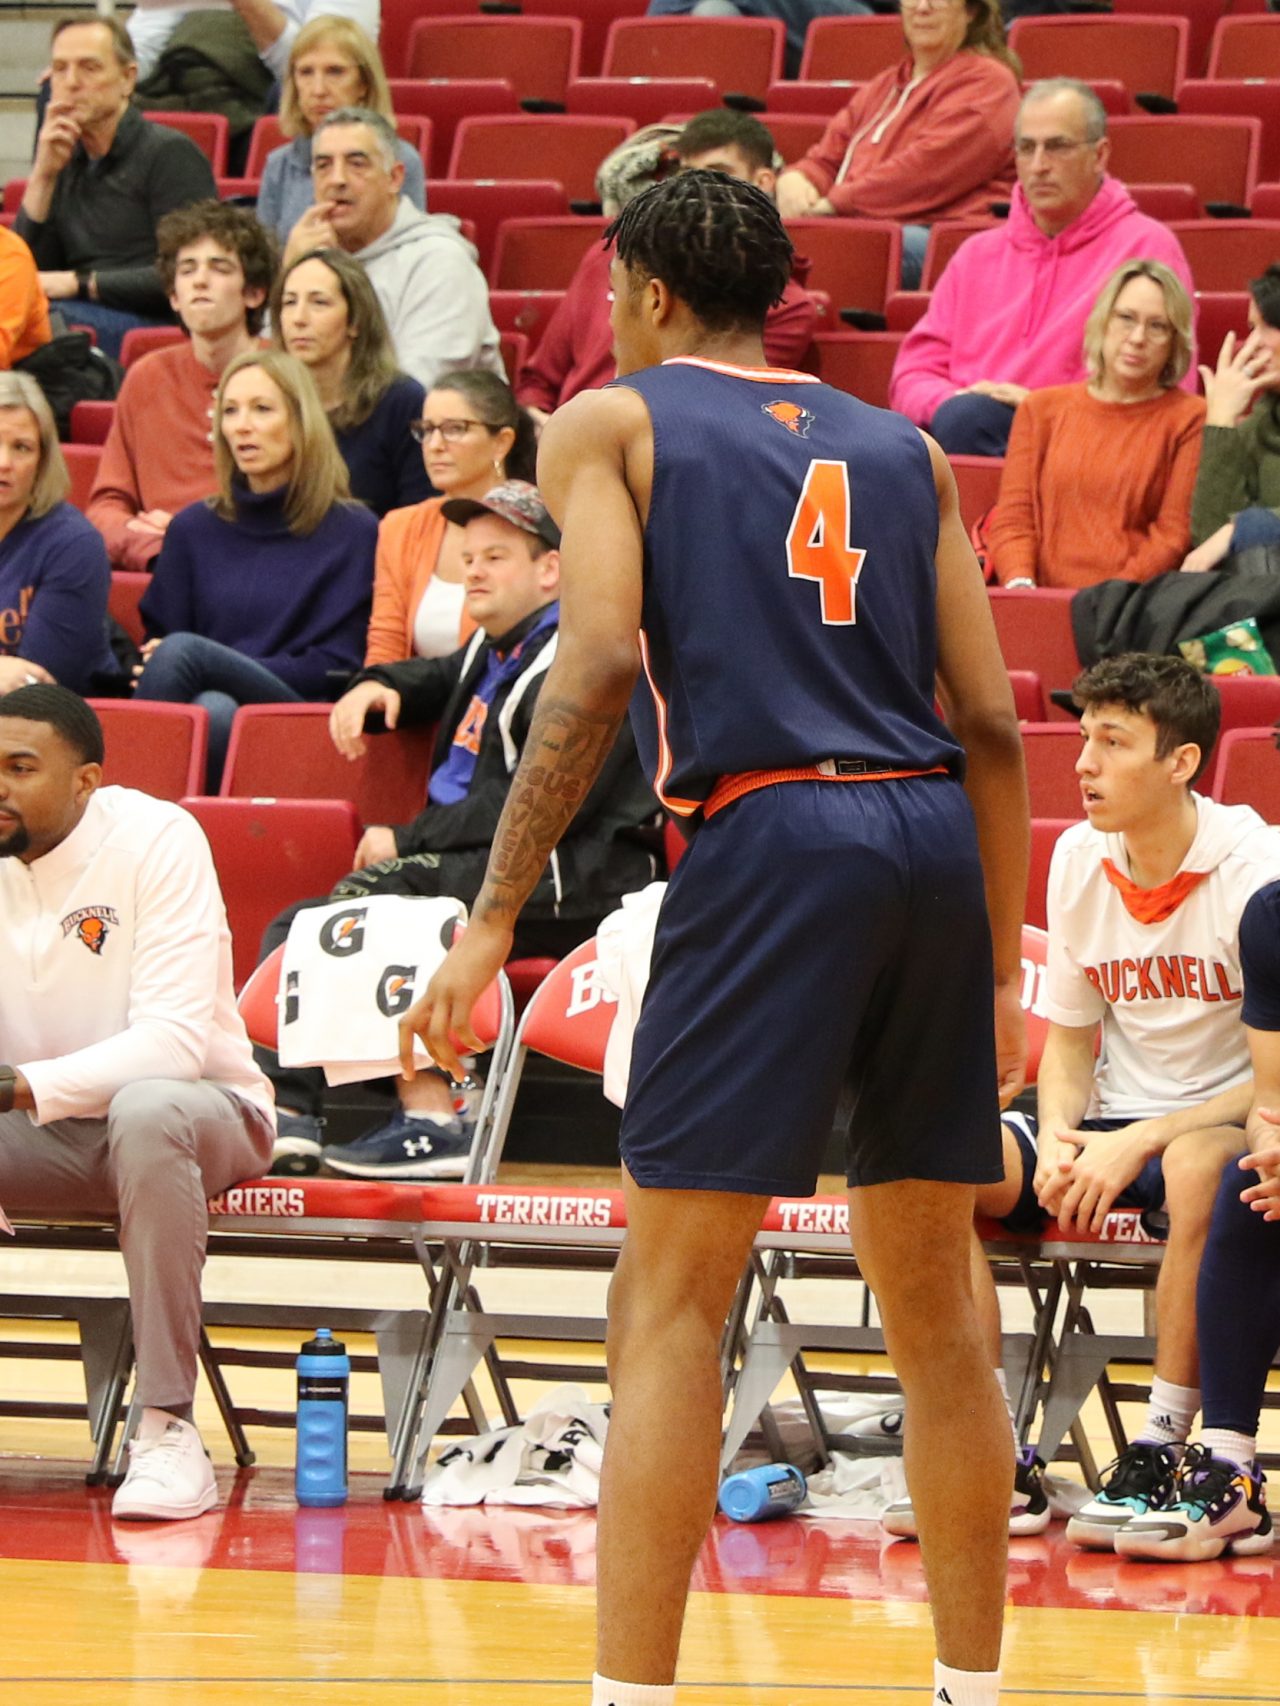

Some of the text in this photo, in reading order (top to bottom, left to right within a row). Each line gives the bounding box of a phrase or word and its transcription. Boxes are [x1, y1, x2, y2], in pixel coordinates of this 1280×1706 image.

[785, 458, 867, 626] 4
[319, 907, 369, 957] G
[376, 964, 418, 1017] G
[1084, 954, 1243, 1003] BUCKNELL
[476, 1194, 612, 1227] TERRIERS
[778, 1203, 849, 1234] TERR
